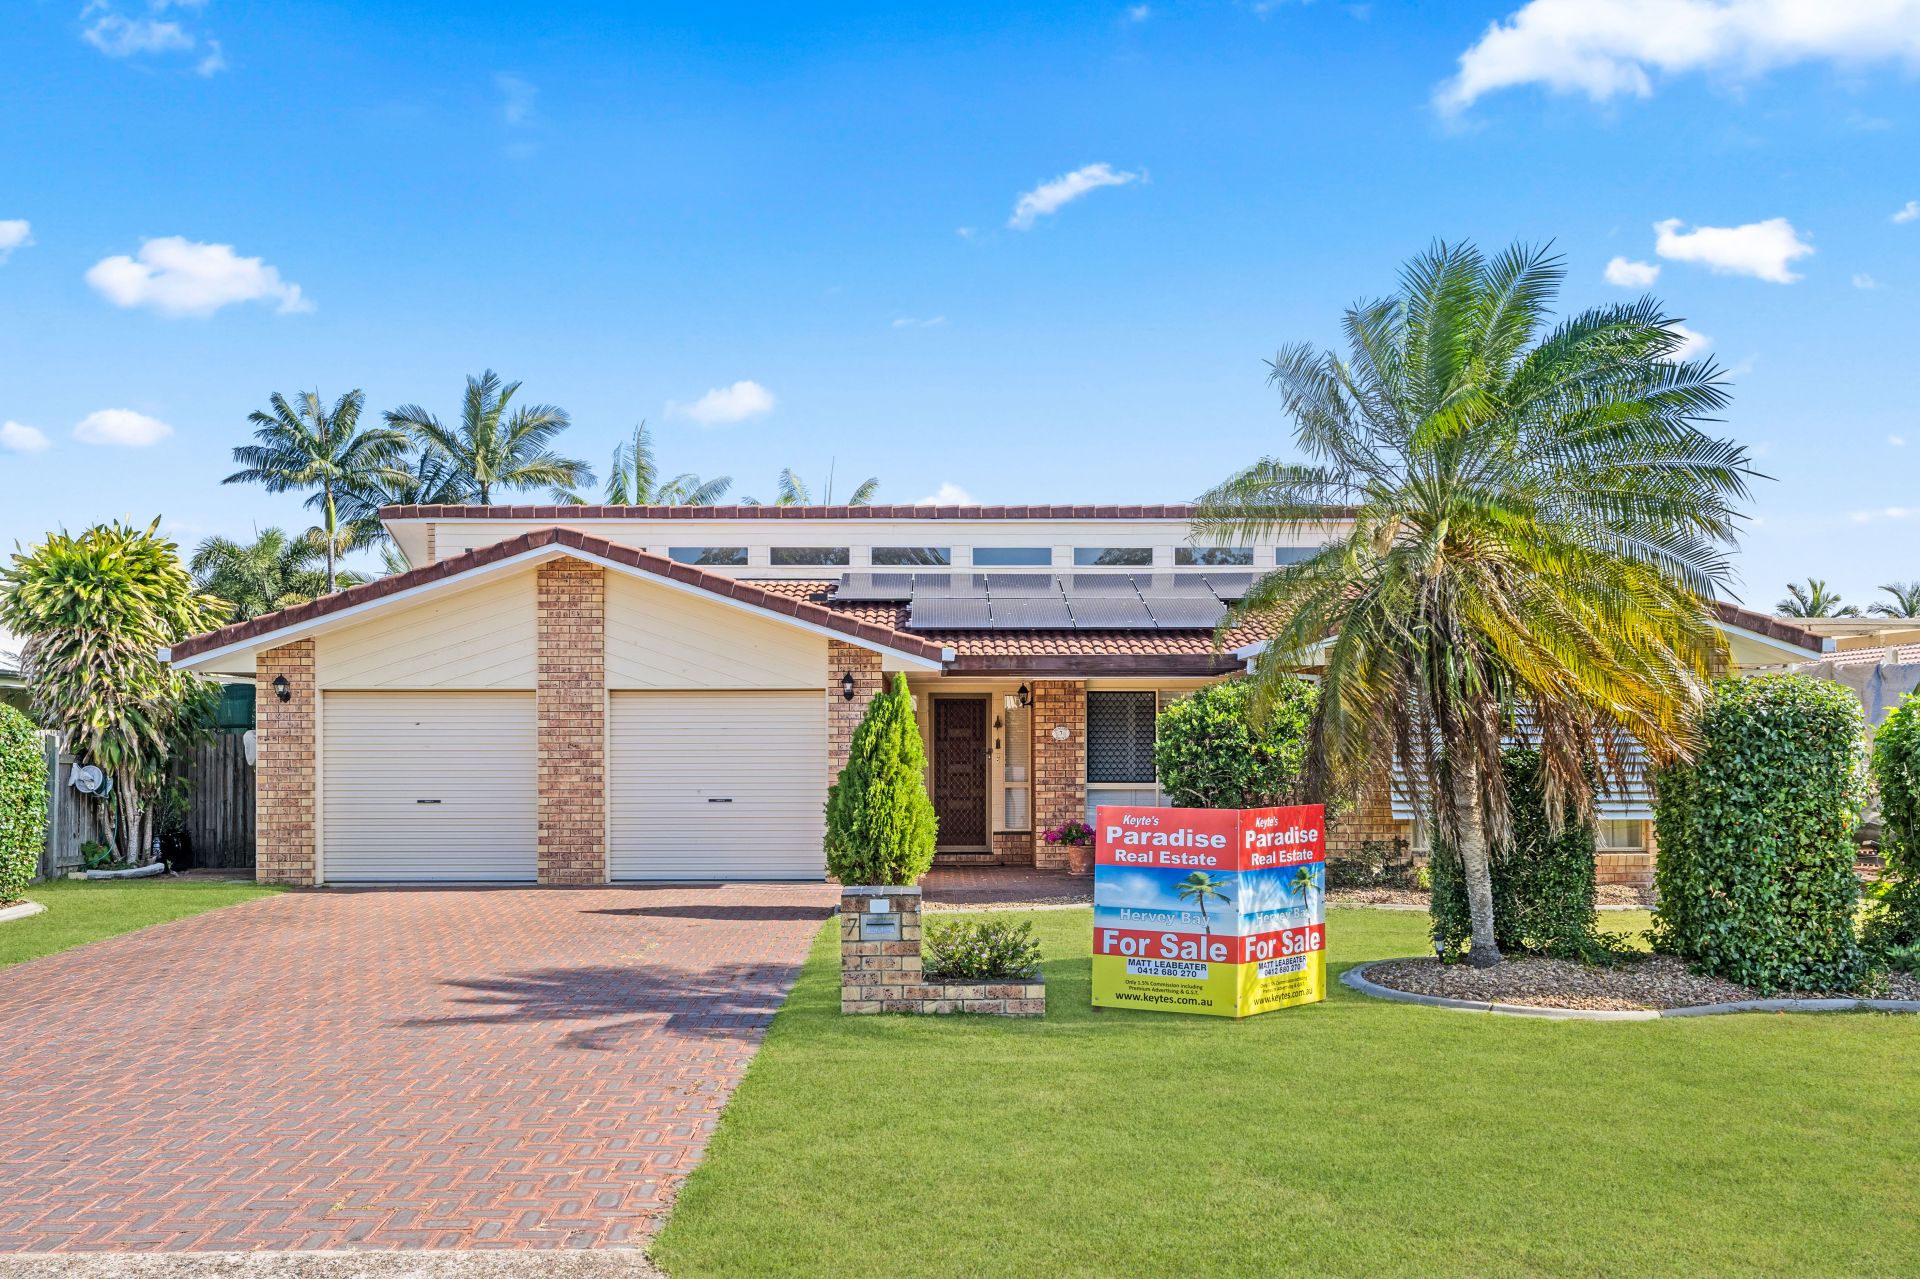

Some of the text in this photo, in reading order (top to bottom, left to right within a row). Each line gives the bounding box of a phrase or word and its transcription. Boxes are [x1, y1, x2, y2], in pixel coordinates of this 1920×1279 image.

[1123, 814, 1159, 828] Keyte's
[1256, 816, 1278, 829] Keyte's
[1106, 826, 1227, 848] Paradise
[1245, 826, 1318, 848] Paradise
[1115, 849, 1217, 866] Real Estate
[1251, 848, 1313, 866] Real Estate
[1120, 908, 1210, 928] Hervey Bay
[847, 917, 858, 937] 7
[1103, 929, 1228, 962] For Sale
[1245, 927, 1321, 962] For Sale
[1128, 958, 1207, 971] MATT LEABEATER
[1258, 955, 1306, 970] MATT LEABEATER
[1264, 967, 1278, 976] 0412
[1290, 963, 1301, 972] 270
[1137, 967, 1197, 978] 0412 680 270
[1115, 992, 1213, 1006] www.keytes.com.au
[1253, 988, 1313, 1006] www.keytes.com.au
